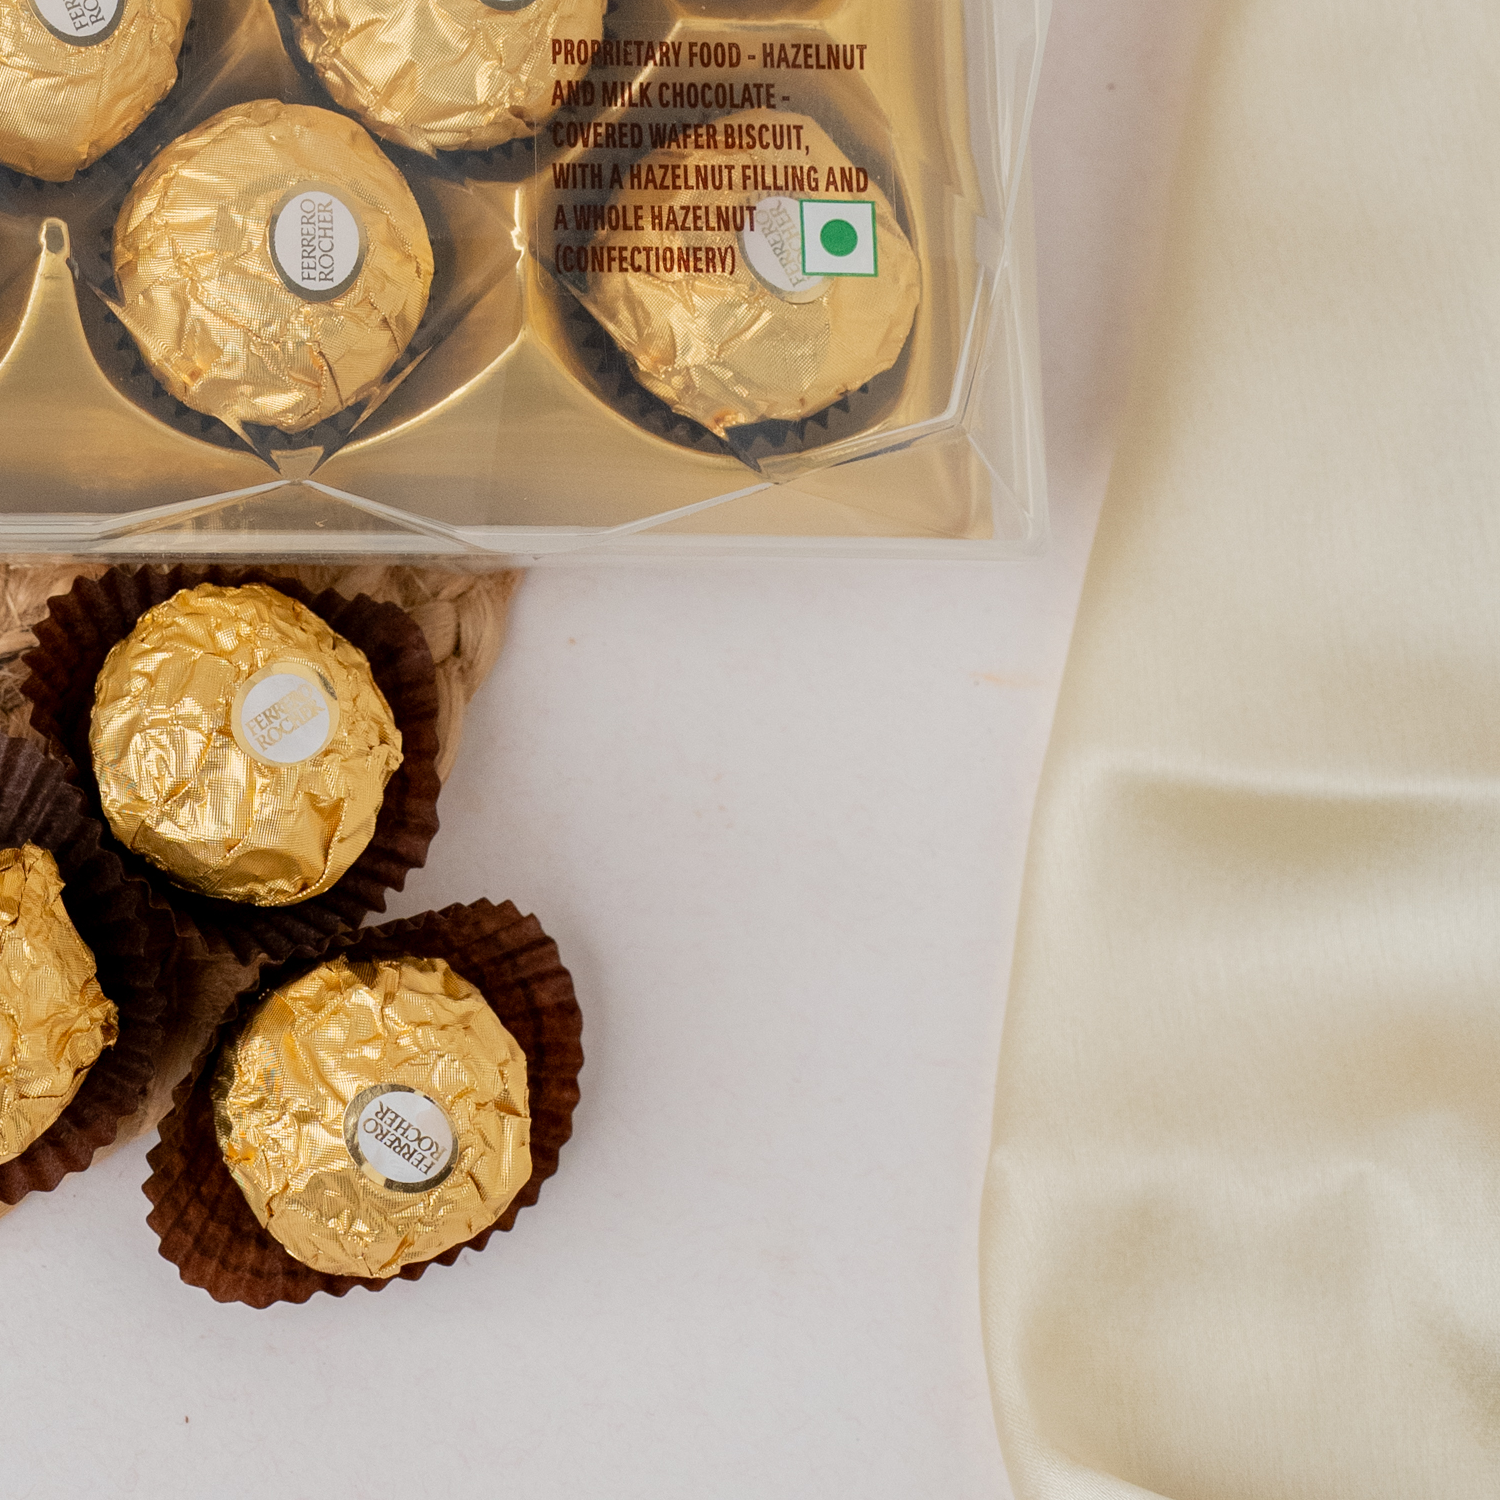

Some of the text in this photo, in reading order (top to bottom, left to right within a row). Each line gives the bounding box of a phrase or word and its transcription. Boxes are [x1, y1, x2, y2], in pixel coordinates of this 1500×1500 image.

[552, 39, 682, 67] PROPRIETARY
[689, 42, 741, 68] FOOD
[762, 43, 867, 70] HAZELNUT
[552, 80, 595, 106] AND
[602, 81, 653, 108] MILK
[658, 82, 777, 109] CHOCOLATE
[552, 121, 809, 155] COVERED WAFER BISCUIT,
[552, 163, 868, 193] WITH A HAZELNUT FILLING AND
[553, 205, 756, 232] A WHOLE HAZELNUT
[300, 199, 316, 282] FERRERO
[318, 199, 334, 283] ROCHER
[554, 246, 736, 275] (CONFECTIONERY)
[245, 684, 314, 736] FERRERO
[255, 698, 326, 752] ROCHER
[362, 1117, 429, 1176] FERRERO
[375, 1100, 448, 1165] ROCHER
